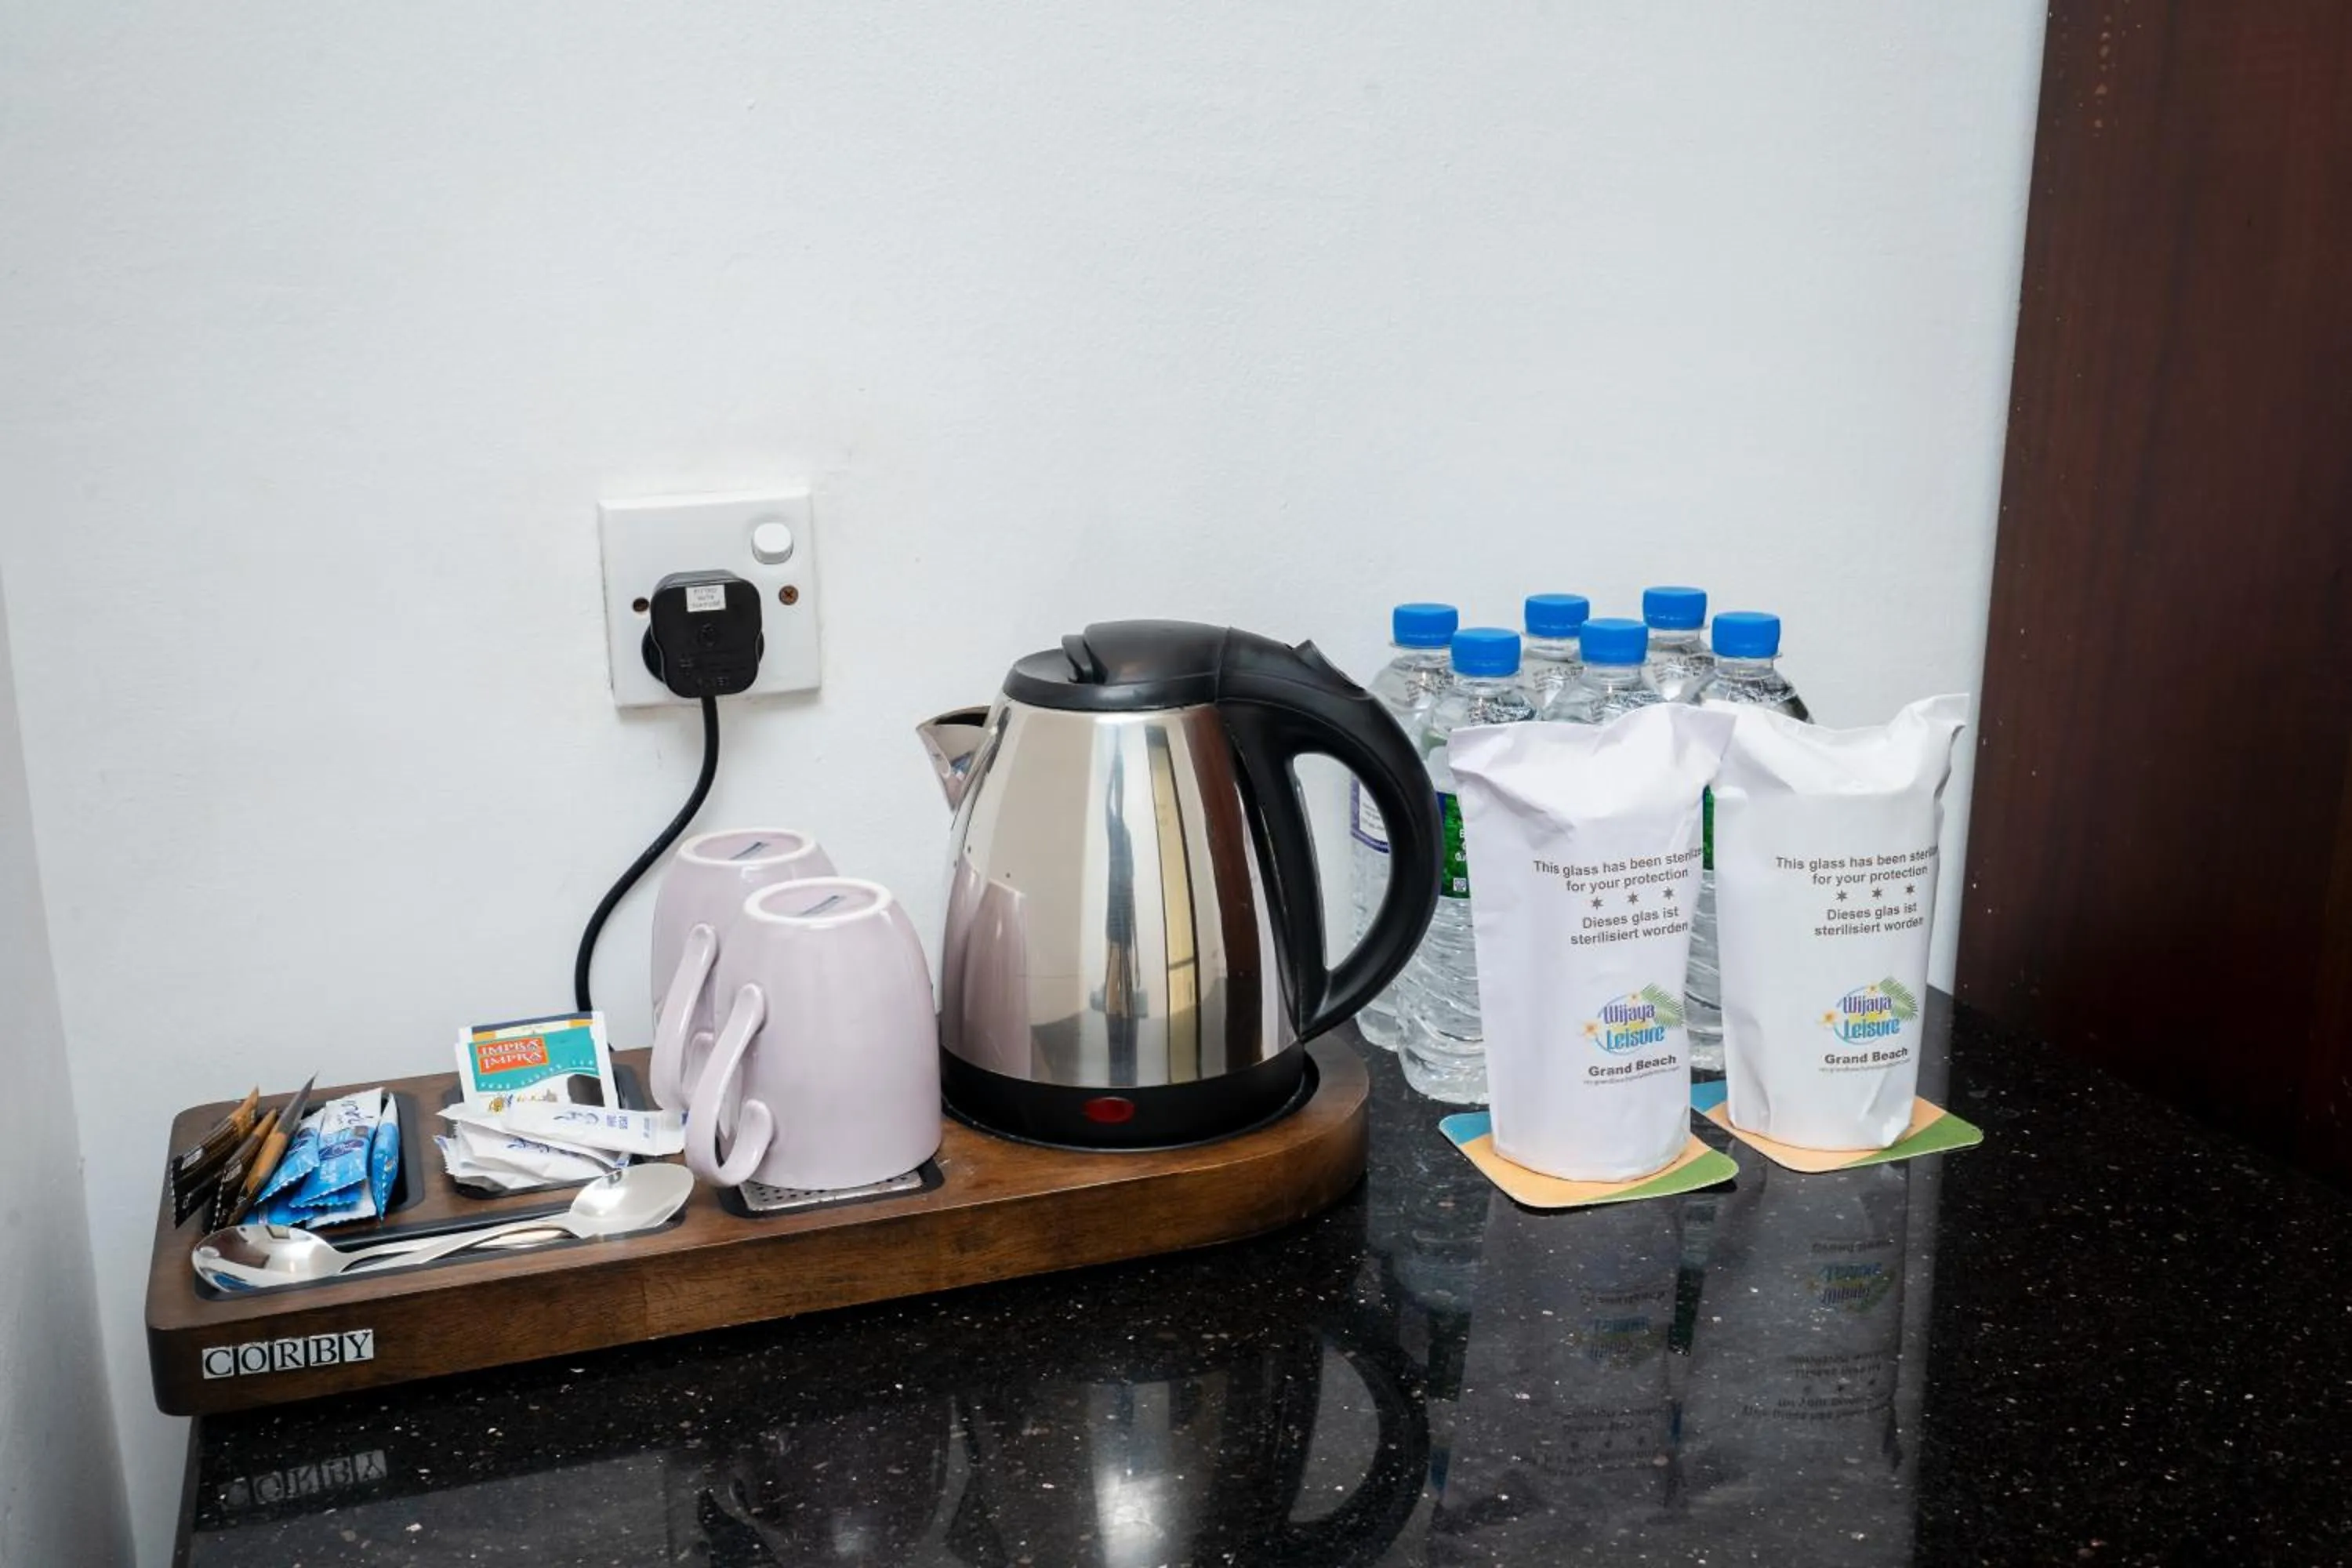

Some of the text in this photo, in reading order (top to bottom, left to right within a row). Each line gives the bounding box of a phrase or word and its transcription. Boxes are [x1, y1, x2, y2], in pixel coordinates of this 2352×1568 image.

[1534, 859, 1560, 875] This
[1563, 863, 1599, 878] glass
[1602, 859, 1627, 874] has
[1630, 854, 1661, 869] been
[1776, 856, 1804, 870] This
[1809, 856, 1846, 872] glass
[1849, 855, 1874, 869] has
[1877, 853, 1906, 866] been
[1566, 867, 1689, 894] for your protection
[1813, 865, 1928, 887] for your protection
[1582, 906, 1679, 929] Dieses glas ist
[1827, 902, 1918, 920] Dieses glas ist
[1570, 921, 1689, 945] sterilisiert worden
[1814, 923, 1881, 937] sterilisiert
[1603, 1003, 1655, 1025] Wijaya
[1843, 995, 1893, 1014] Wijaya
[1606, 1025, 1665, 1050] Leisure
[1843, 1018, 1900, 1040] Leisure
[1588, 1062, 1632, 1076] Grand
[1635, 1054, 1677, 1071] Beach
[1823, 1053, 1868, 1065] Grand
[1871, 1047, 1908, 1062] Beach
[204, 1331, 372, 1376] CORBY
